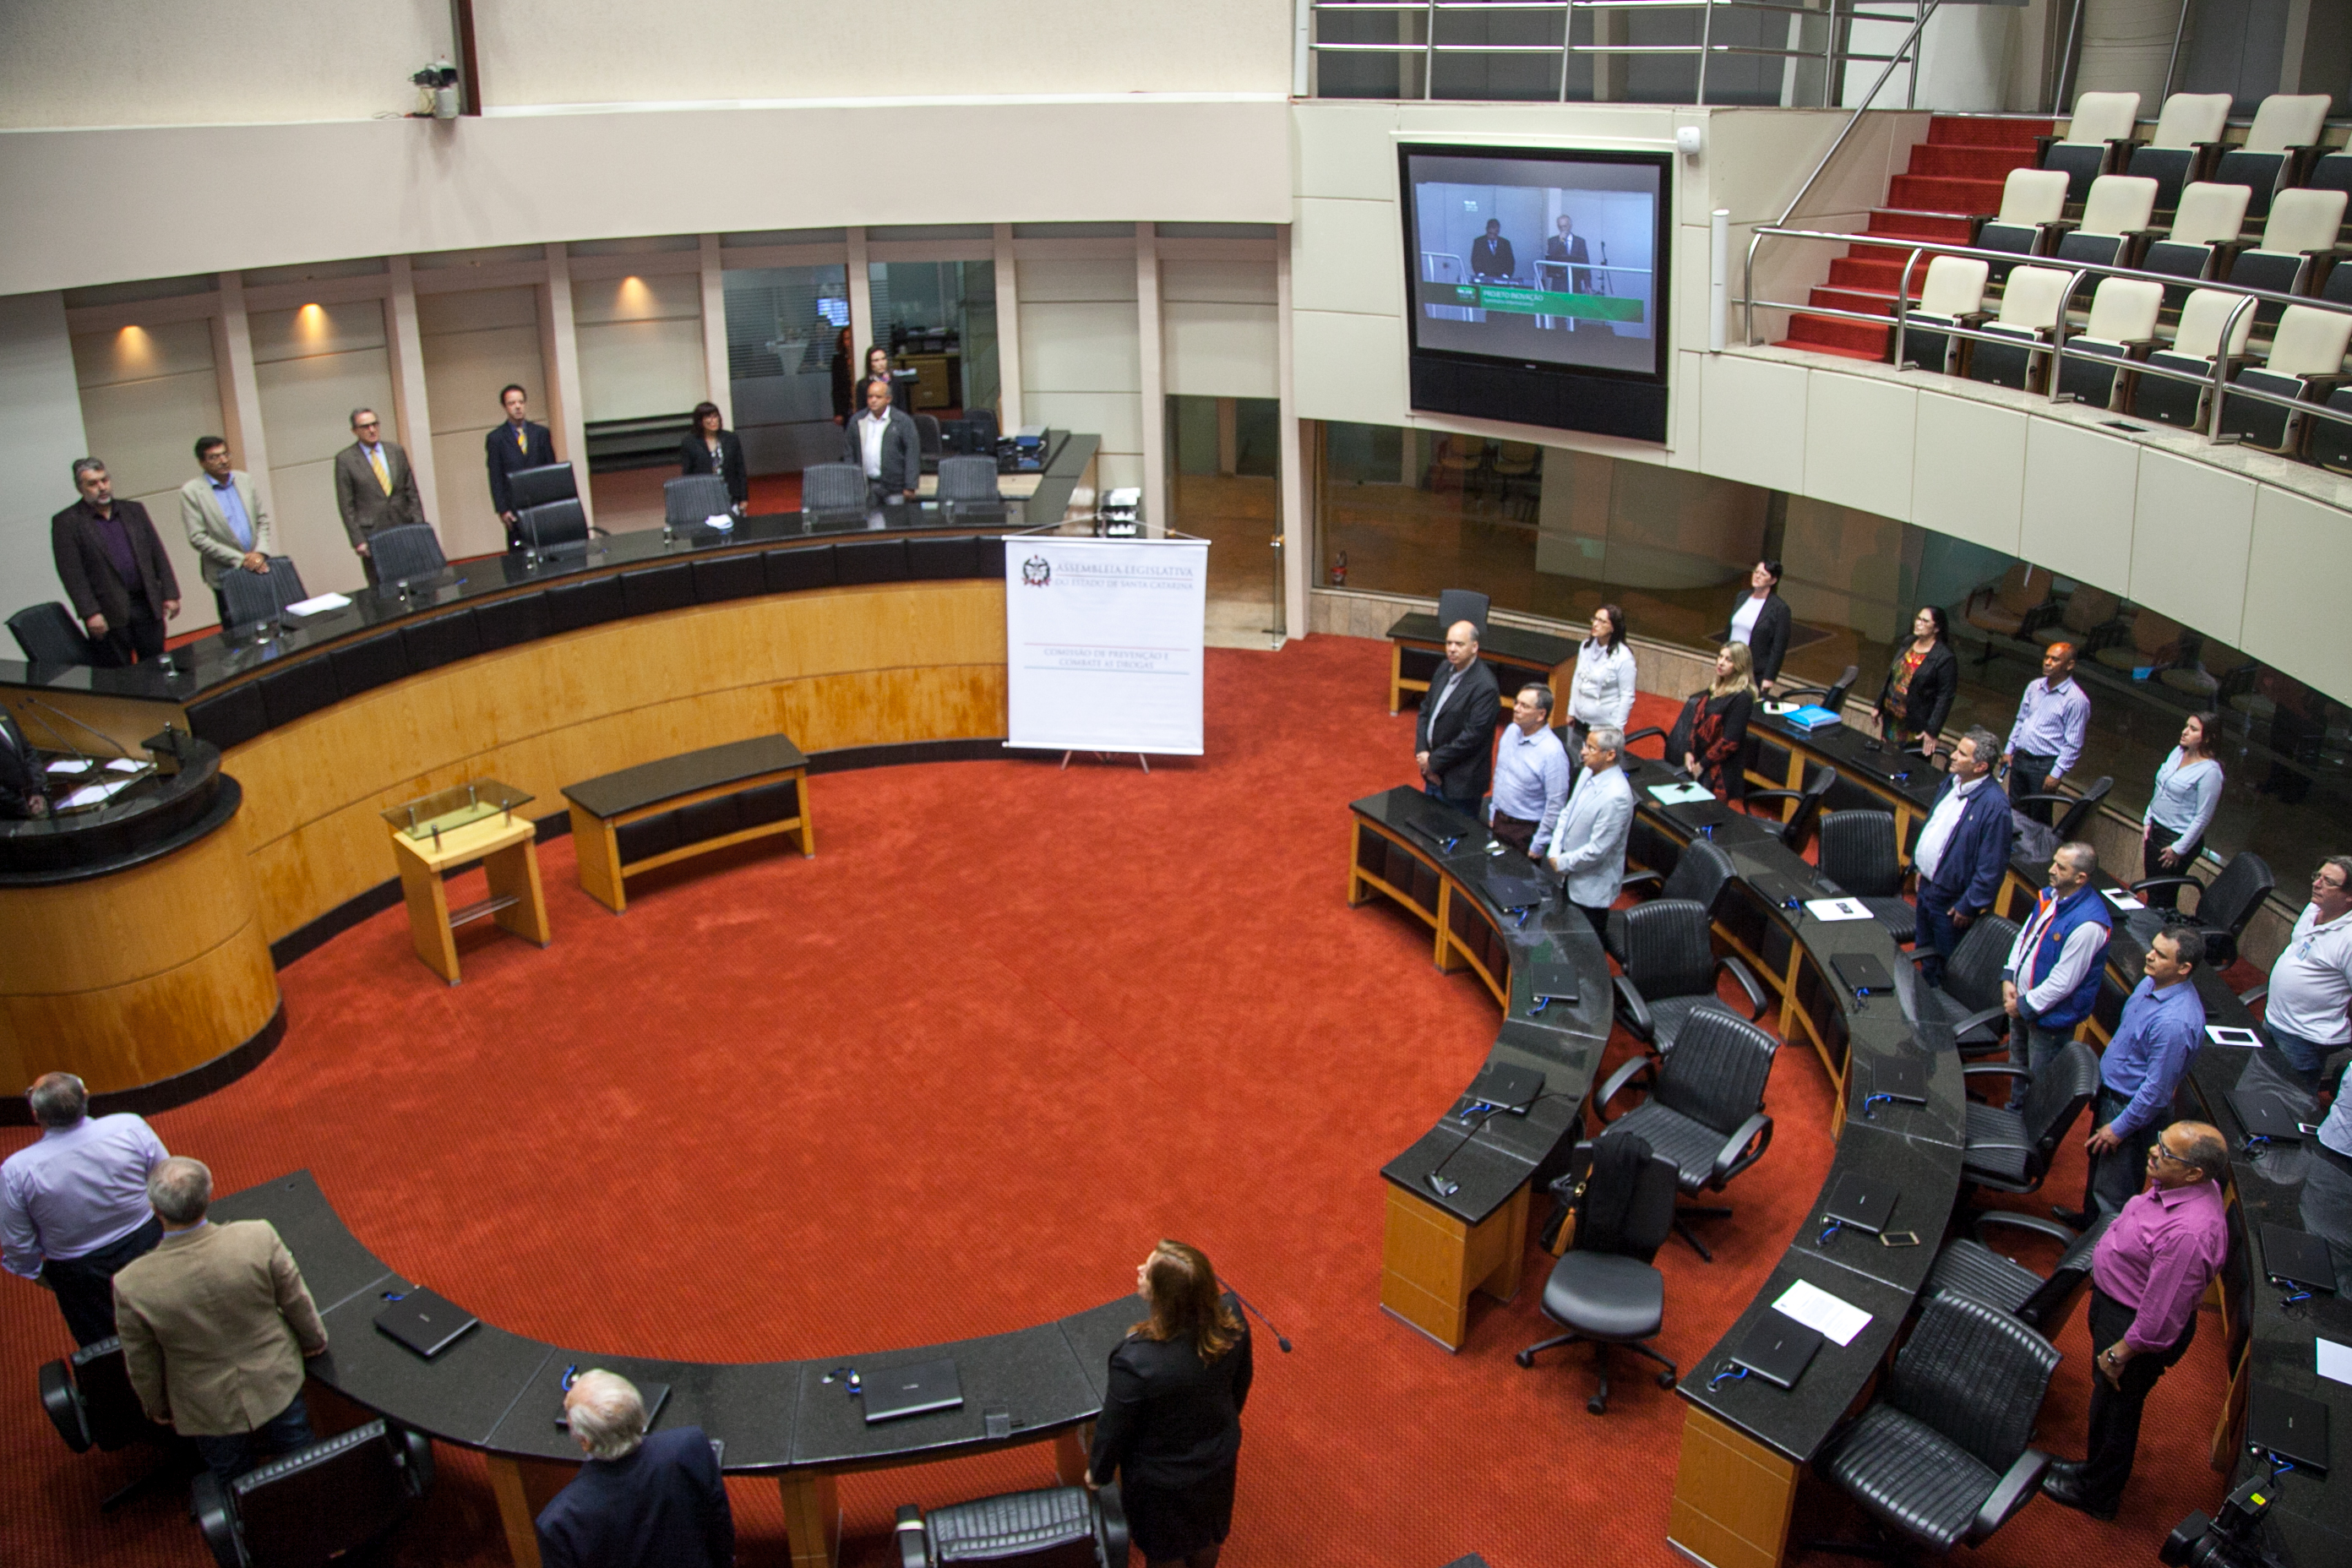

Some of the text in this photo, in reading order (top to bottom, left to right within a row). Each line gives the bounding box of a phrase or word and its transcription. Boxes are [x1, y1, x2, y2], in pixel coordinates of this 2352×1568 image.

[1056, 564, 1194, 576] ASSEMBLEIA LEGISLATIVA
[1071, 579, 1104, 587] ESTADO
[1107, 580, 1118, 588] DE
[1120, 580, 1147, 589] SANTA
